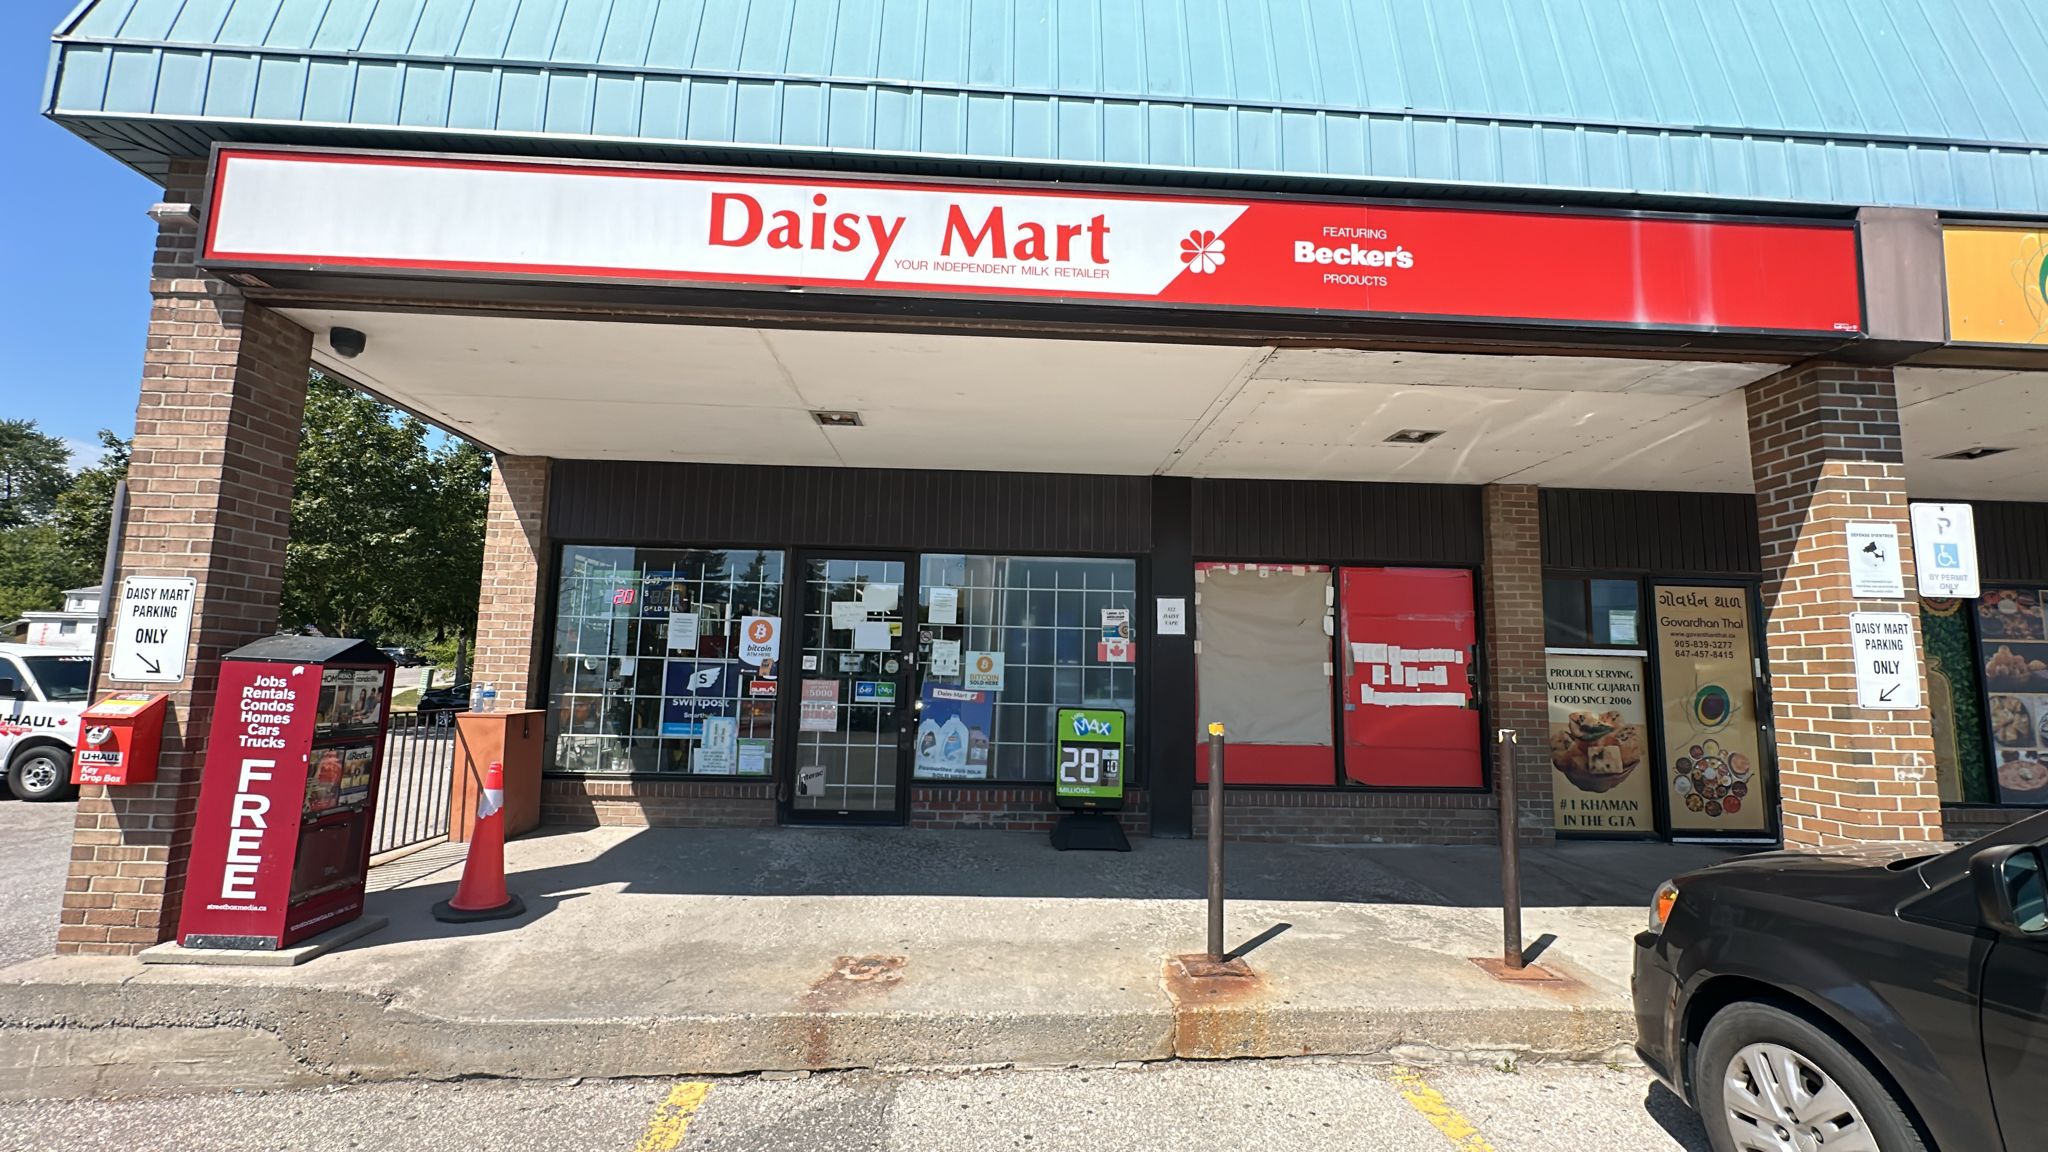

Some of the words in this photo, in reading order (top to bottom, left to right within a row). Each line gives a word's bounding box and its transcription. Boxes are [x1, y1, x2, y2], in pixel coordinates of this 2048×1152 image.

[709, 192, 907, 281] Daisy
[940, 204, 1111, 264] Mart
[1323, 226, 1388, 240] FEATURING
[1294, 240, 1414, 269] Becker's
[894, 259, 929, 271] YOUR
[933, 261, 1016, 275] INDEPENDENT
[1021, 266, 1049, 276] MILK
[1054, 267, 1110, 279] RETAILER
[1323, 273, 1388, 287] PRODUCTS
[1941, 574, 1969, 582] PERMIT
[126, 588, 157, 600] DAISY
[160, 589, 190, 601] MART
[613, 588, 635, 605] 20
[132, 605, 178, 618] PARKING
[1660, 616, 1719, 628] Govardhan
[1721, 618, 1744, 629] Thal
[1855, 623, 1880, 634] DAISY
[1884, 624, 1908, 635] MART
[135, 628, 168, 644] ONLY
[747, 644, 772, 652] bitcoin
[1674, 640, 1733, 649] 905-839-3277
[1865, 639, 1904, 651] PARKING
[1675, 650, 1734, 659] 647-457-8415
[1550, 668, 1593, 678] PROUDLY
[1595, 669, 1633, 679] SERVING
[1873, 660, 1900, 675] ONLY
[253, 675, 287, 688] Jobs
[1547, 682, 1596, 692] AUTHENTIC
[1597, 683, 1641, 693] GUJARATI
[242, 686, 296, 700] Rentals
[240, 698, 295, 712] Condos
[1554, 695, 1580, 704] FOOD
[1582, 696, 1607, 705] SINCE
[1609, 697, 1632, 705] 2006
[0, 713, 56, 728] -HAUL
[240, 711, 291, 725] Homes
[247, 723, 280, 737] Cars
[1073, 718, 1111, 736] MAX
[239, 735, 286, 749] Trucks
[81, 753, 120, 761] U-HAUL
[80, 765, 99, 775] Key
[1060, 747, 1099, 783] 28
[80, 773, 102, 784] Drop
[103, 774, 121, 783] Box
[1059, 786, 1090, 794] MILLIONS
[1580, 800, 1639, 811] KHAMAN
[1563, 814, 1576, 826] IN
[1580, 815, 1602, 826] THE
[1608, 816, 1637, 827] GTA
[221, 758, 276, 899] FREE
